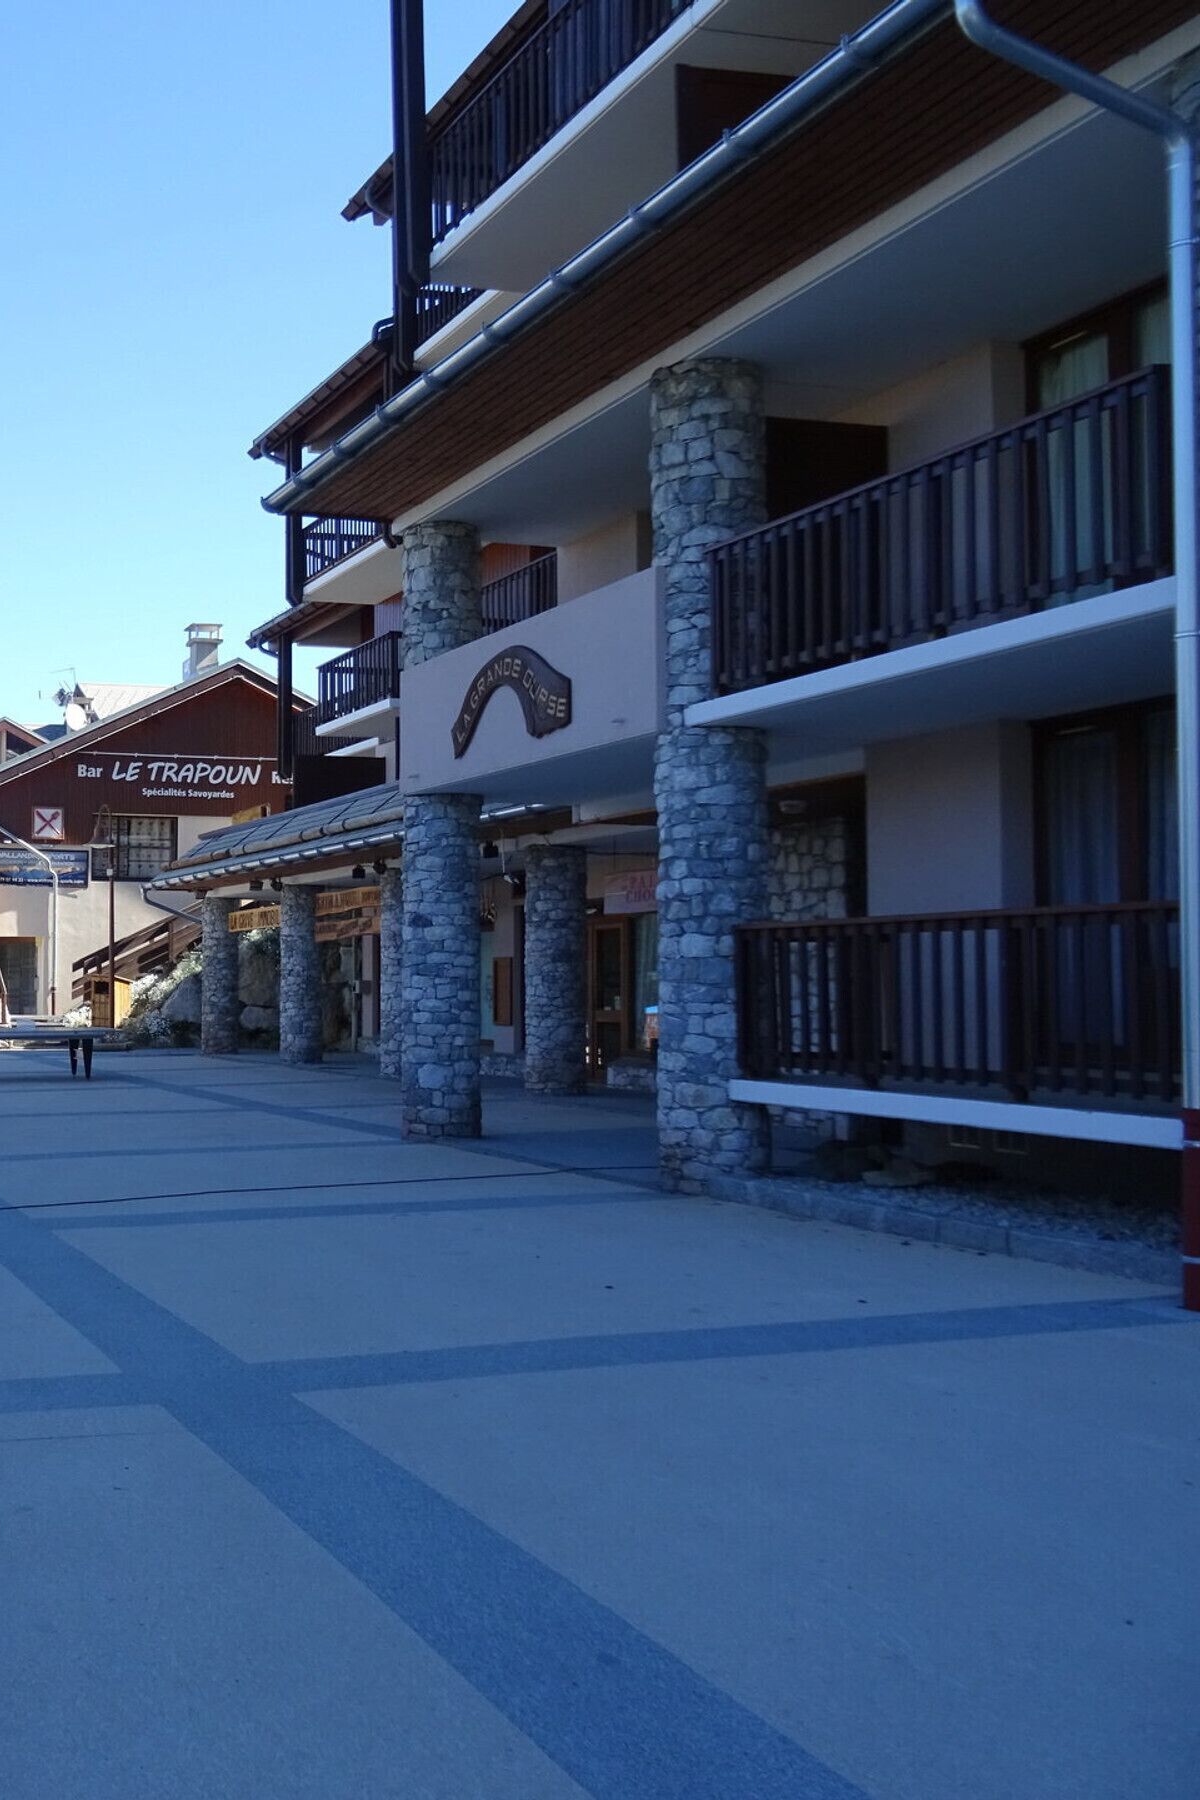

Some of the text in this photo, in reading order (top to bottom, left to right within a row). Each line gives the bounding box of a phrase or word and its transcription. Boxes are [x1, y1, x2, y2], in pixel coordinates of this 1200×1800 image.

[456, 658, 567, 743] LA GRANDE OURSE
[77, 764, 103, 778] Bar
[111, 761, 143, 781] LE
[147, 762, 261, 785] TRAPOUN
[142, 787, 235, 798] Spécialités Savoyardes
